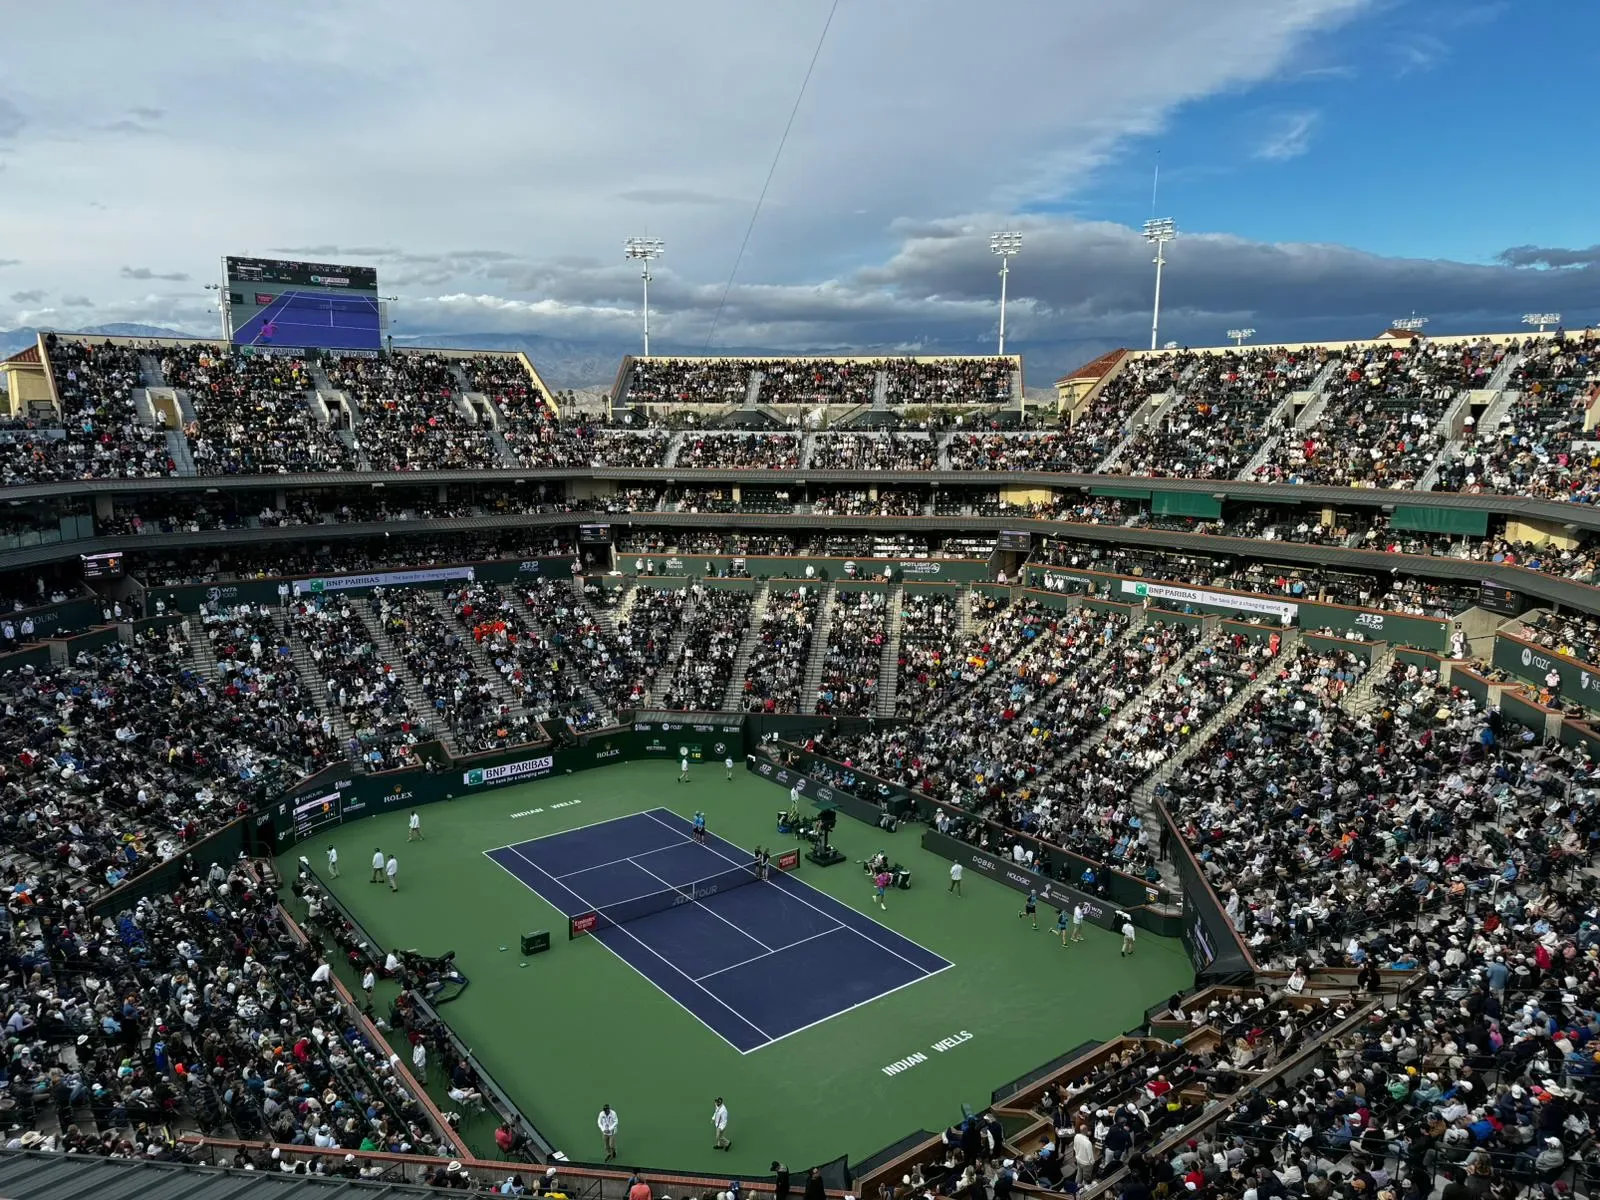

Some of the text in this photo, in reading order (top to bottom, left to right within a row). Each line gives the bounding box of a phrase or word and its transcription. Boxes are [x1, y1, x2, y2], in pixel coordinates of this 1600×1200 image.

[326, 576, 380, 587] BNP PARIBAS
[1149, 586, 1197, 600] BNP PARIBAS
[1355, 613, 1384, 624] ATP
[1532, 655, 1551, 670] razr
[596, 749, 620, 759] ROLEX
[486, 758, 550, 779] BNP PARIBAS
[384, 791, 413, 803] ROLEX
[510, 799, 582, 819] INDIAN WELLS
[972, 855, 996, 870] DOBEL
[1006, 871, 1031, 886] HOLOGIC
[881, 1030, 974, 1077] INDIAN WELLS
